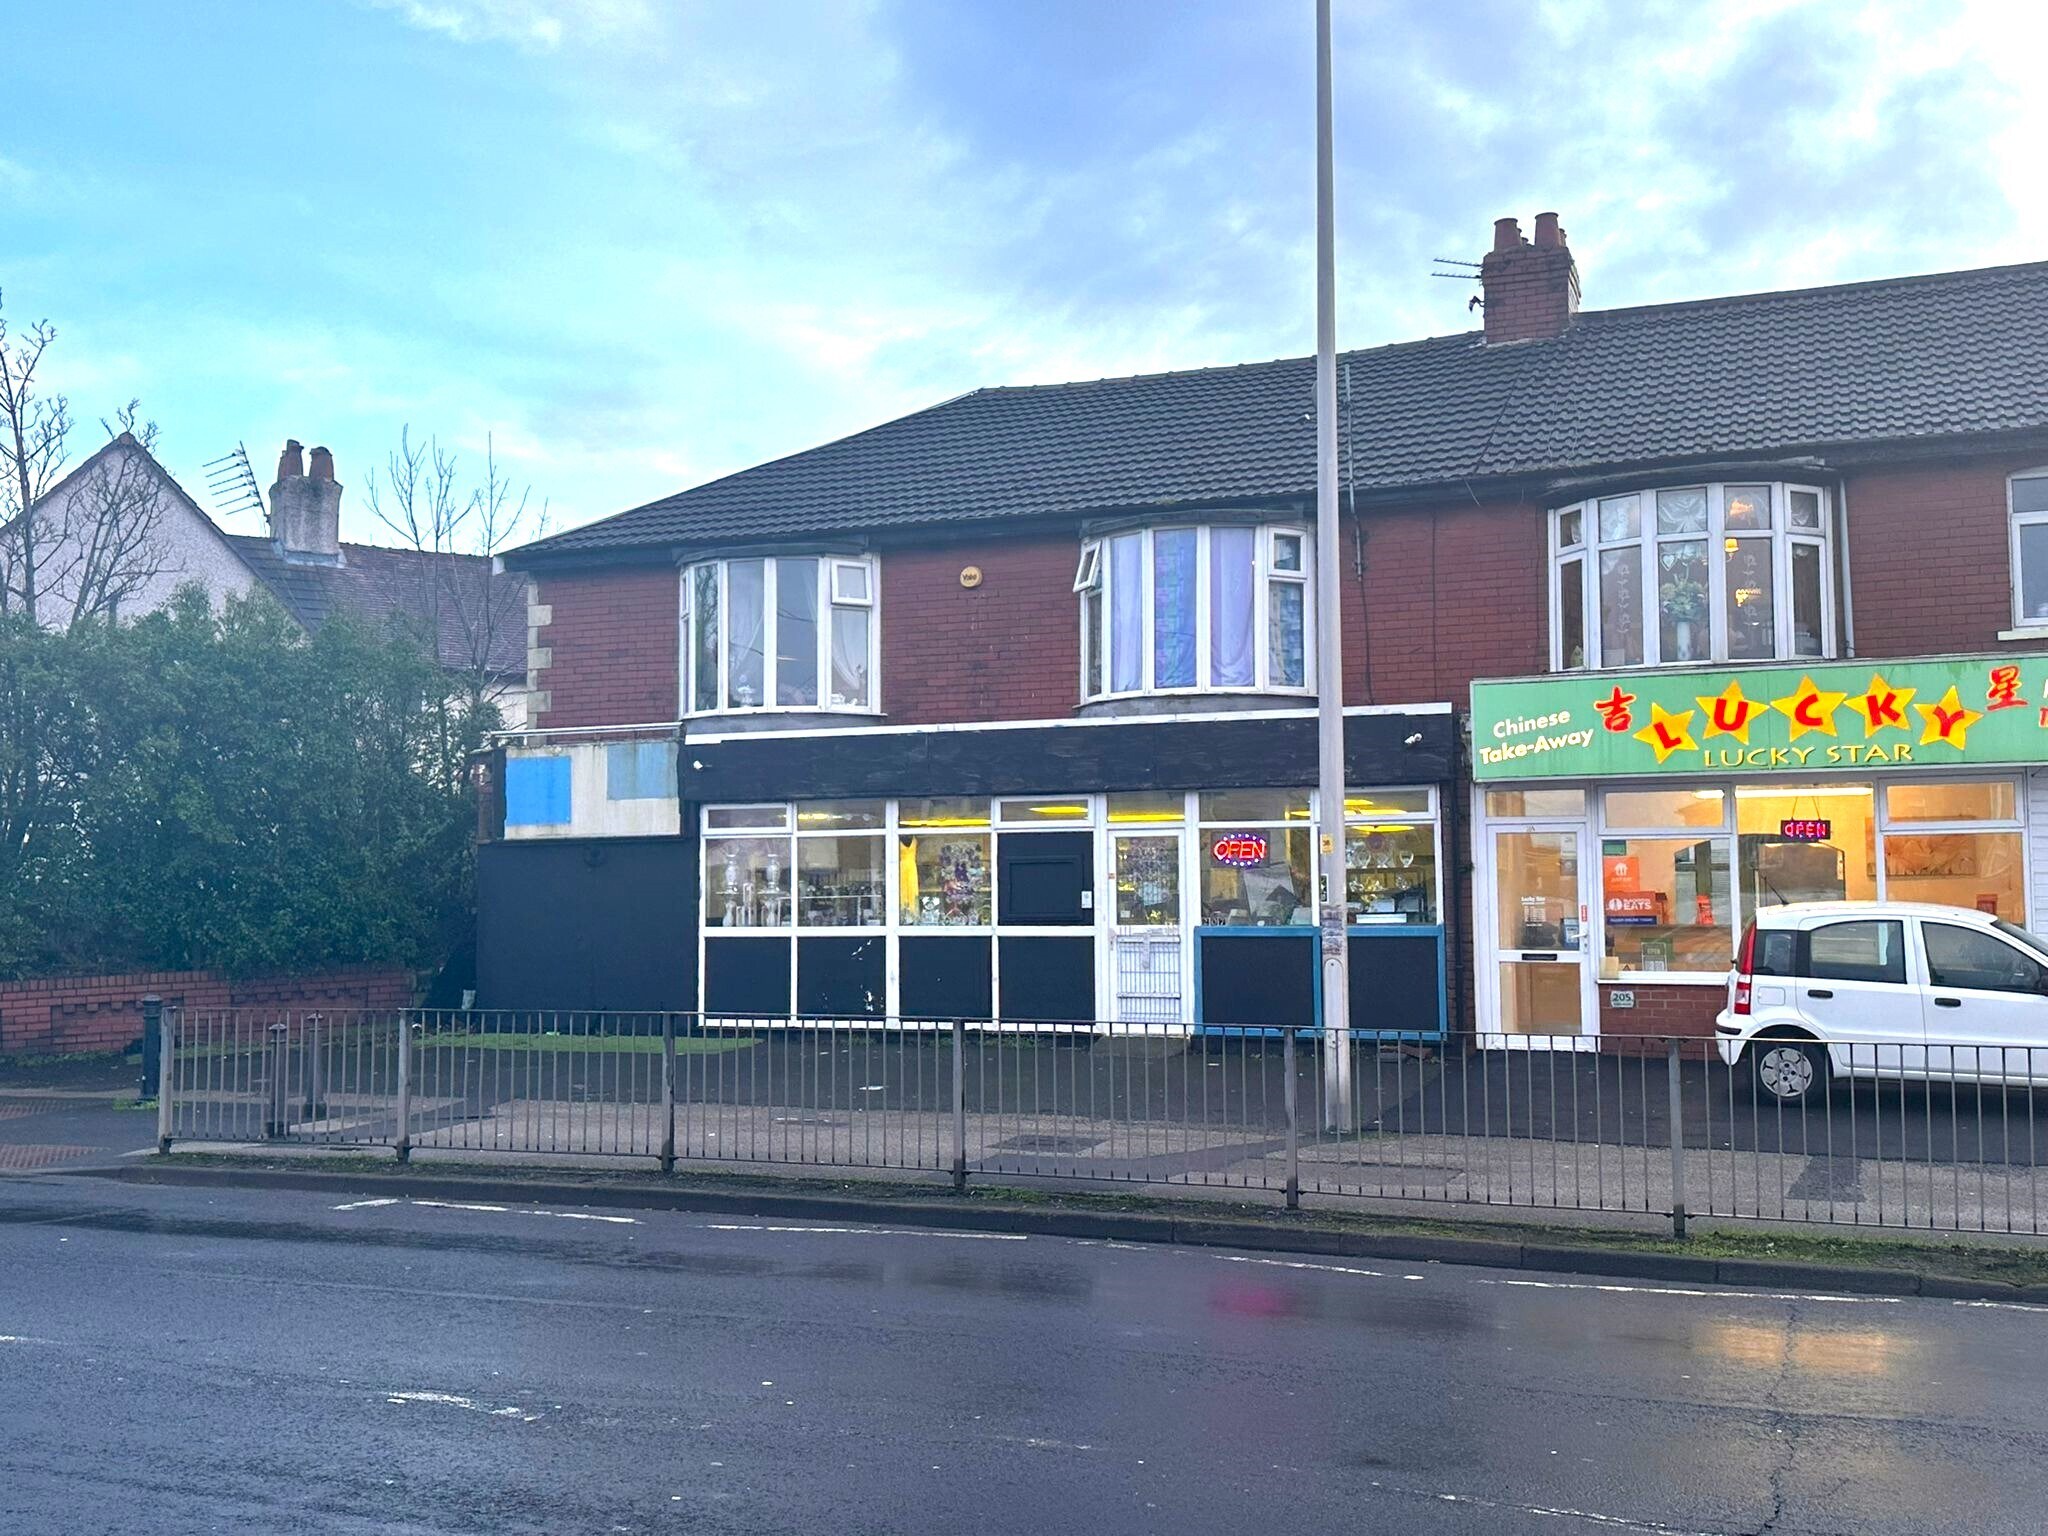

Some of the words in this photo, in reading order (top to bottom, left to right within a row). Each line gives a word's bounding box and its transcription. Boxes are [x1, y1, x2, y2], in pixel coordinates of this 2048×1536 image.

[1986, 665, 2028, 711] 星
[1594, 685, 1636, 733] 吉
[1653, 692, 1965, 750] LUCKY
[1493, 711, 1571, 738] Chinese
[1479, 728, 1594, 765] Take-Away
[1704, 746, 1814, 768] LUCKY
[1828, 743, 1914, 764] STAR
[1784, 821, 1826, 838] OPEN
[1213, 840, 1266, 860] OPEN
[1613, 993, 1631, 1002] 205
